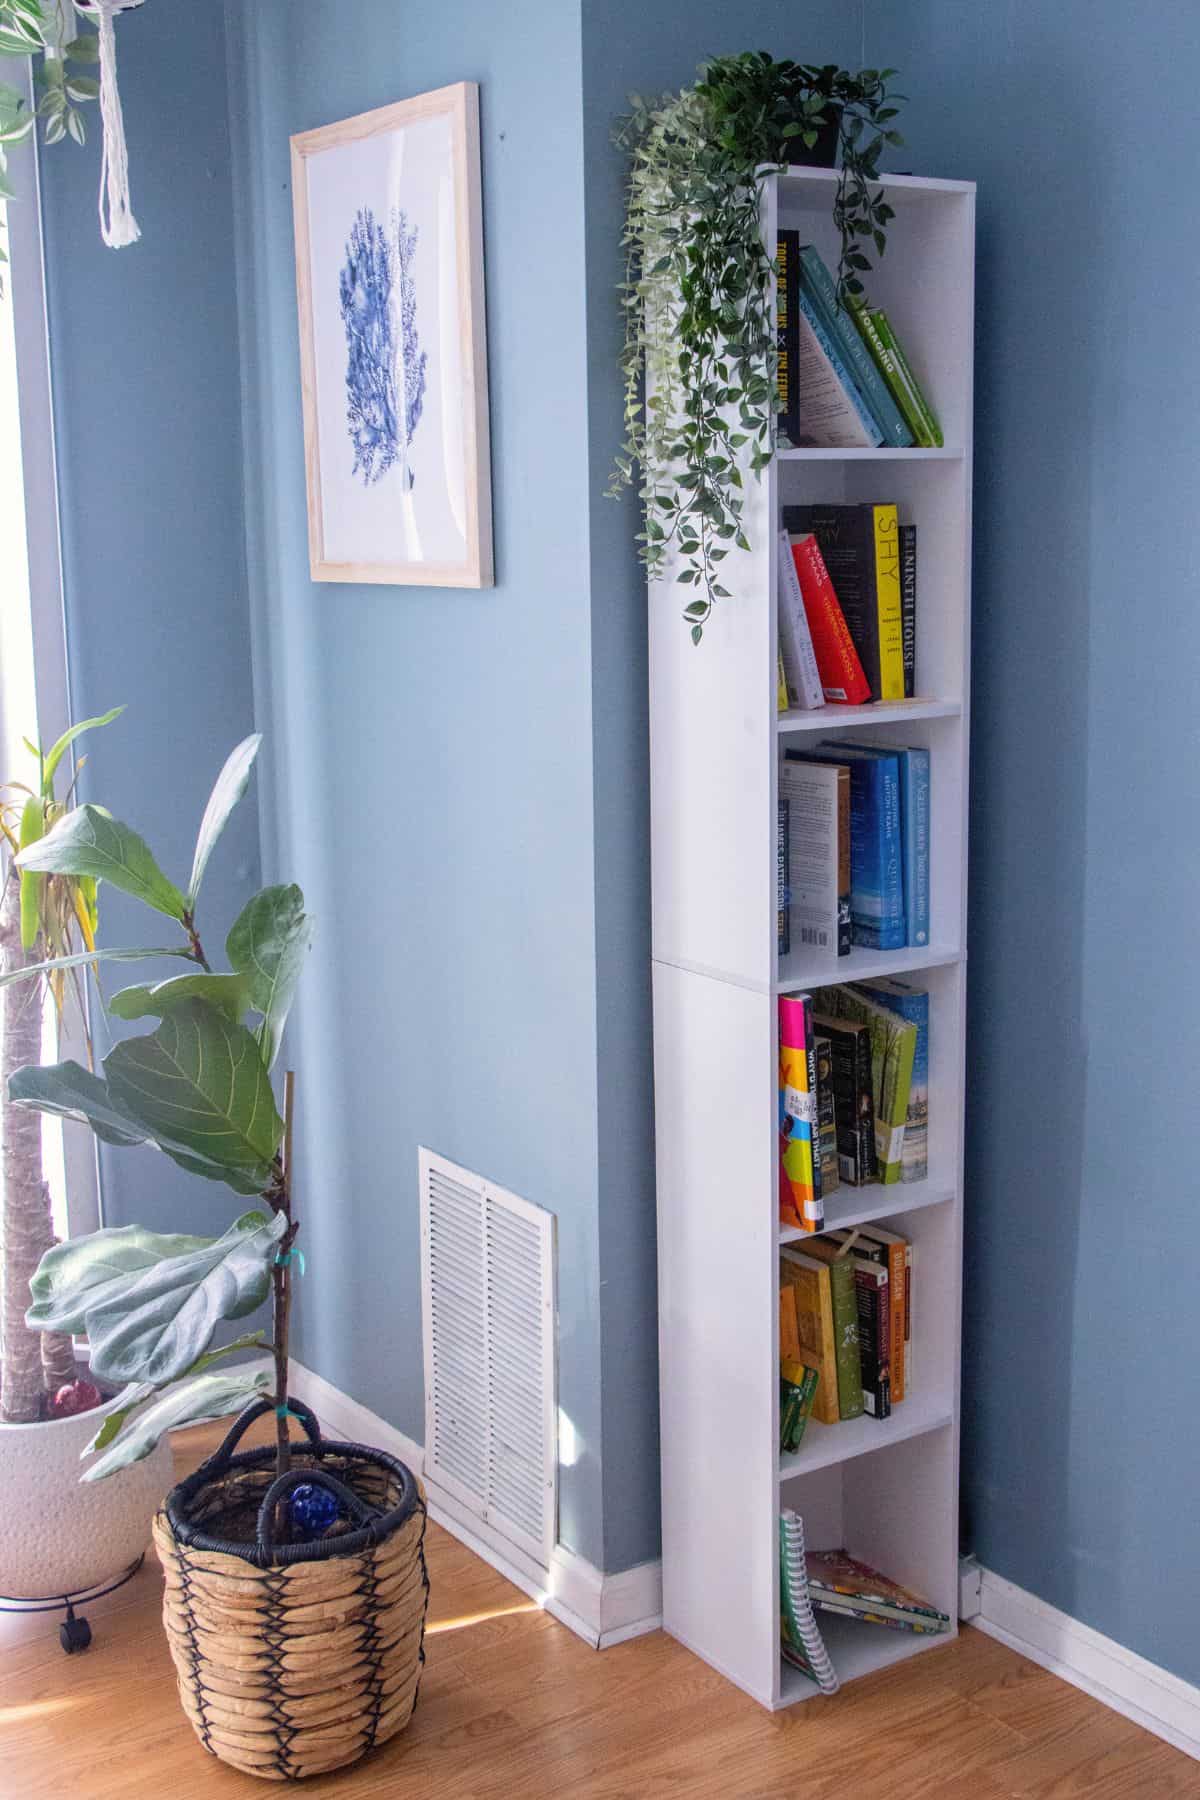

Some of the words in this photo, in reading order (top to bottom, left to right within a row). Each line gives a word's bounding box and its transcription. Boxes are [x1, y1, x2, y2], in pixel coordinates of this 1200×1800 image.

[777, 292, 788, 329] TANS
[860, 308, 894, 374] FORAGING
[878, 517, 899, 581] SHY
[904, 556, 915, 609] NINTH
[903, 616, 915, 670] HOUSE
